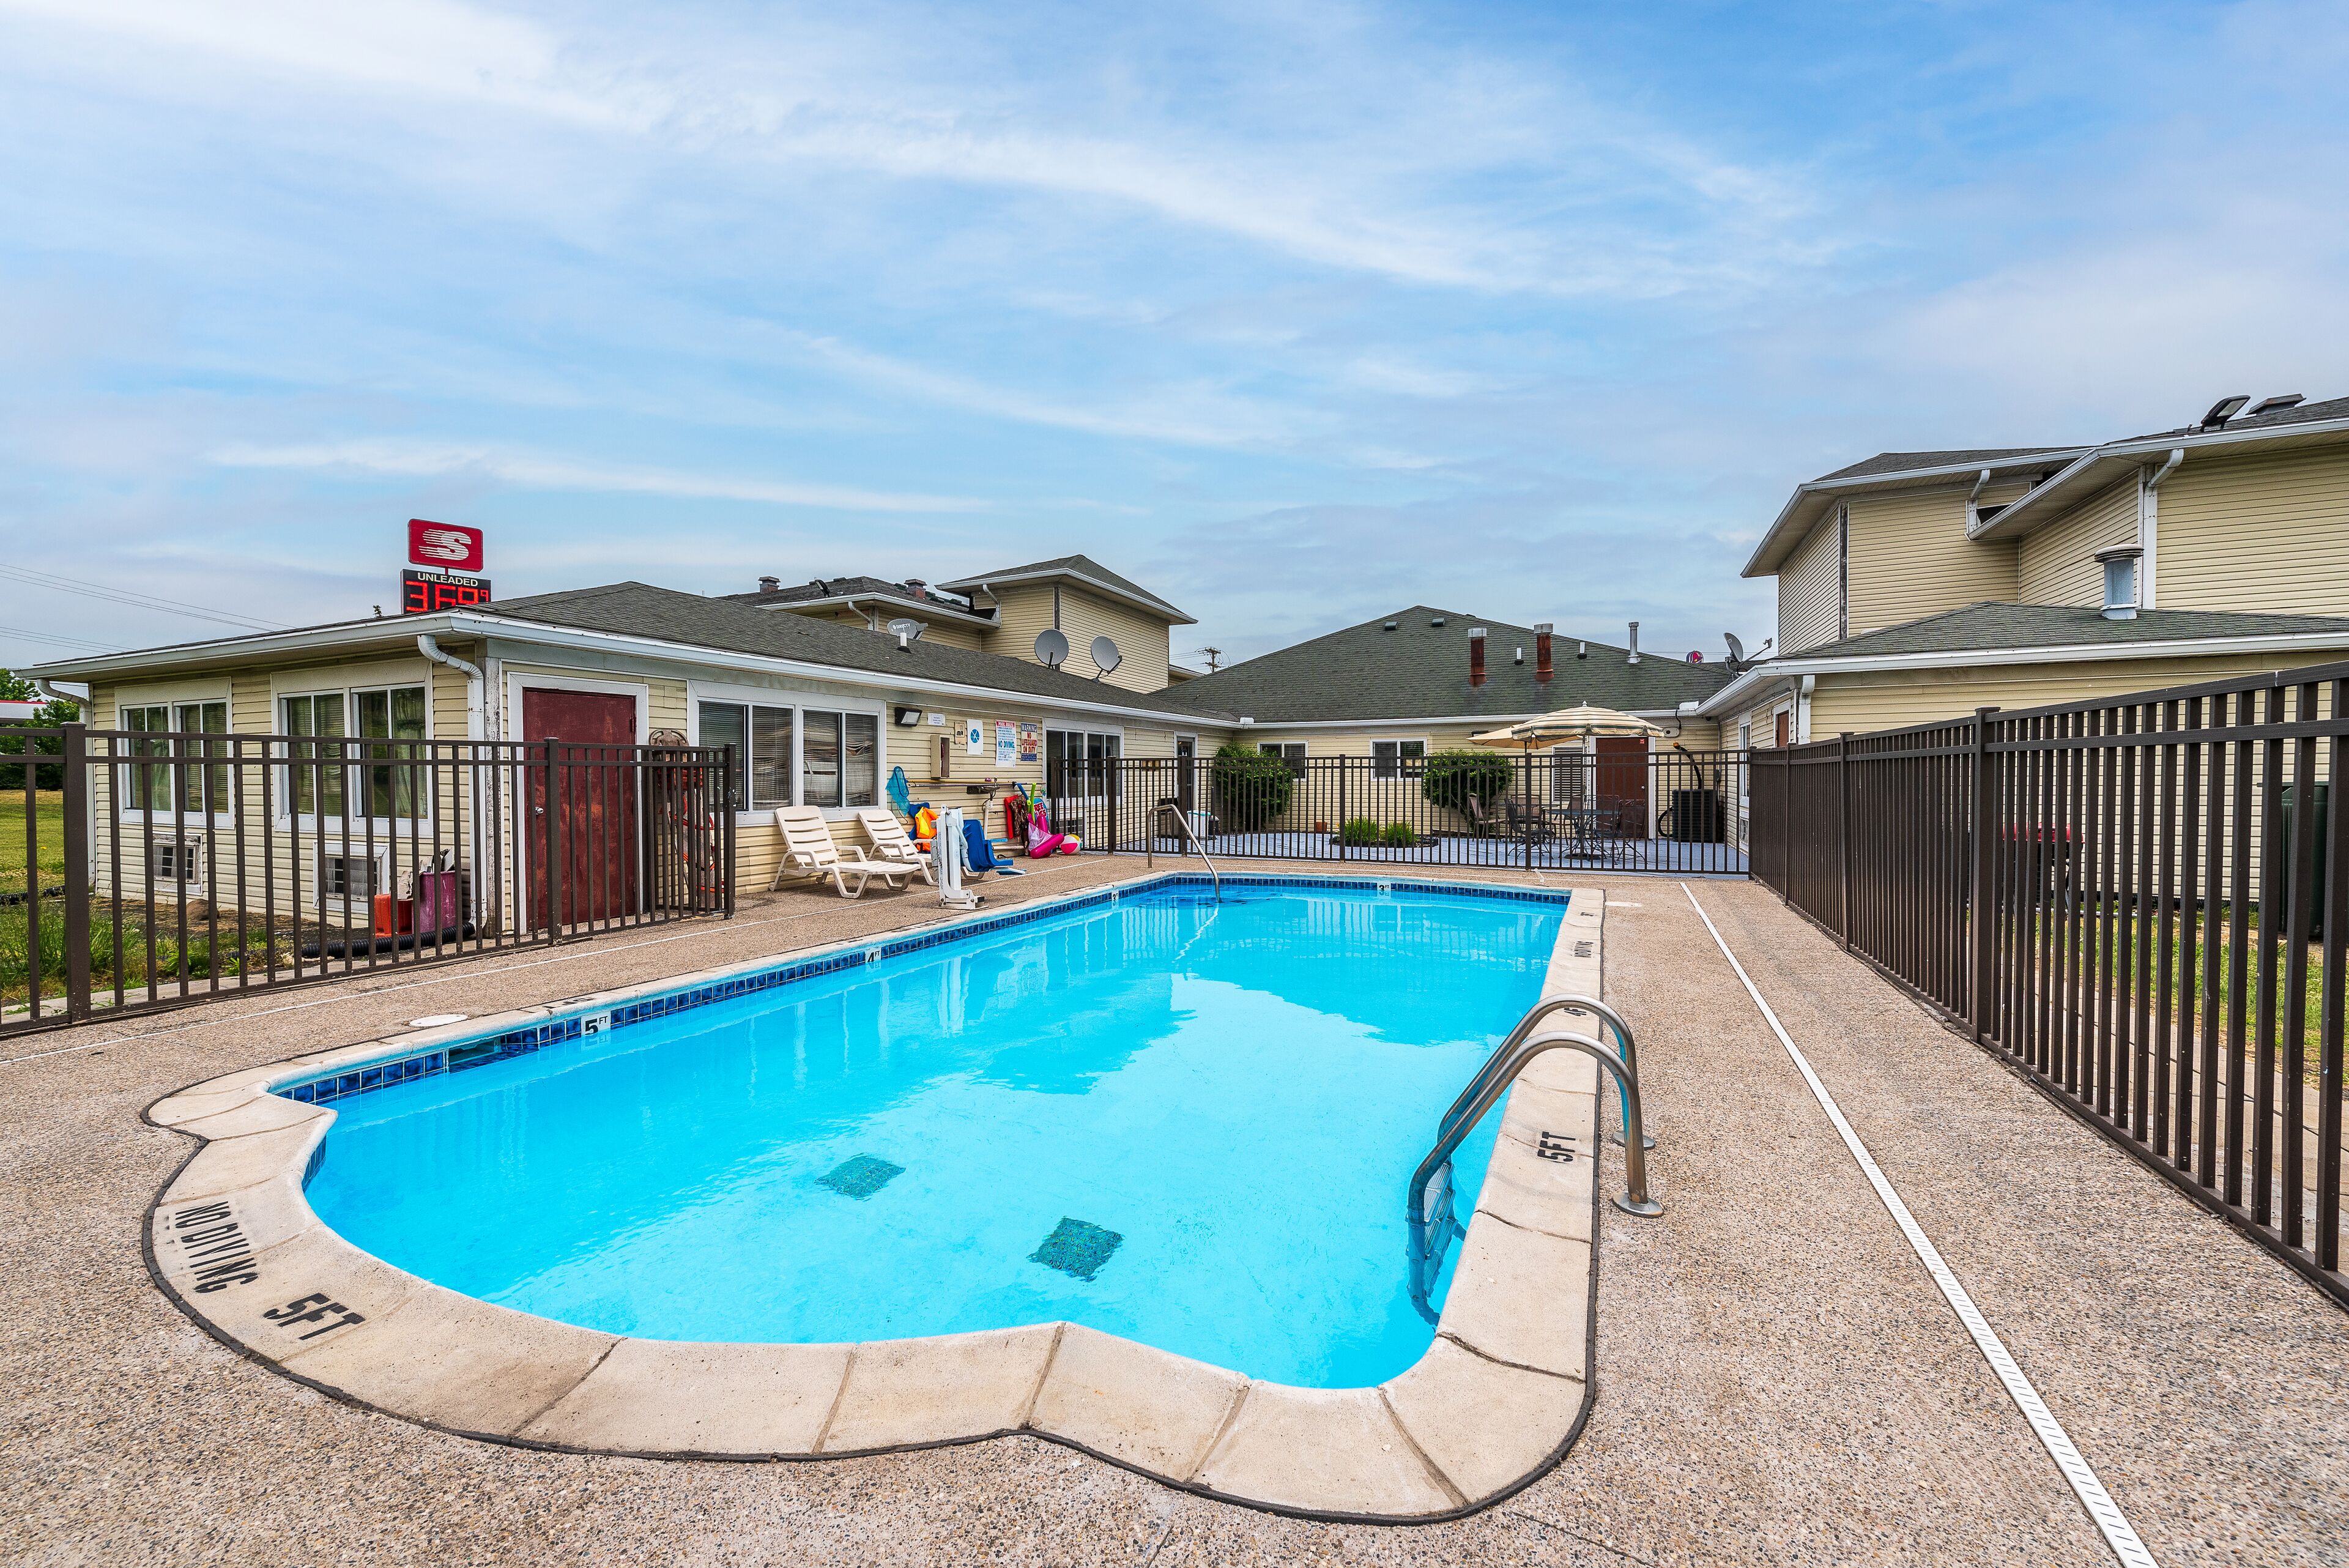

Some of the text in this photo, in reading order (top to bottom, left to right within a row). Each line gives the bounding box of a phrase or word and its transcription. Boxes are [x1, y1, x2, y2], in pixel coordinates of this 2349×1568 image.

[417, 572, 478, 586] UNLEADED
[1022, 724, 1037, 732] WARNING
[585, 1016, 608, 1035] 5 FT
[1537, 1131, 1576, 1163] 5FT
[263, 1292, 366, 1340] 5FT
